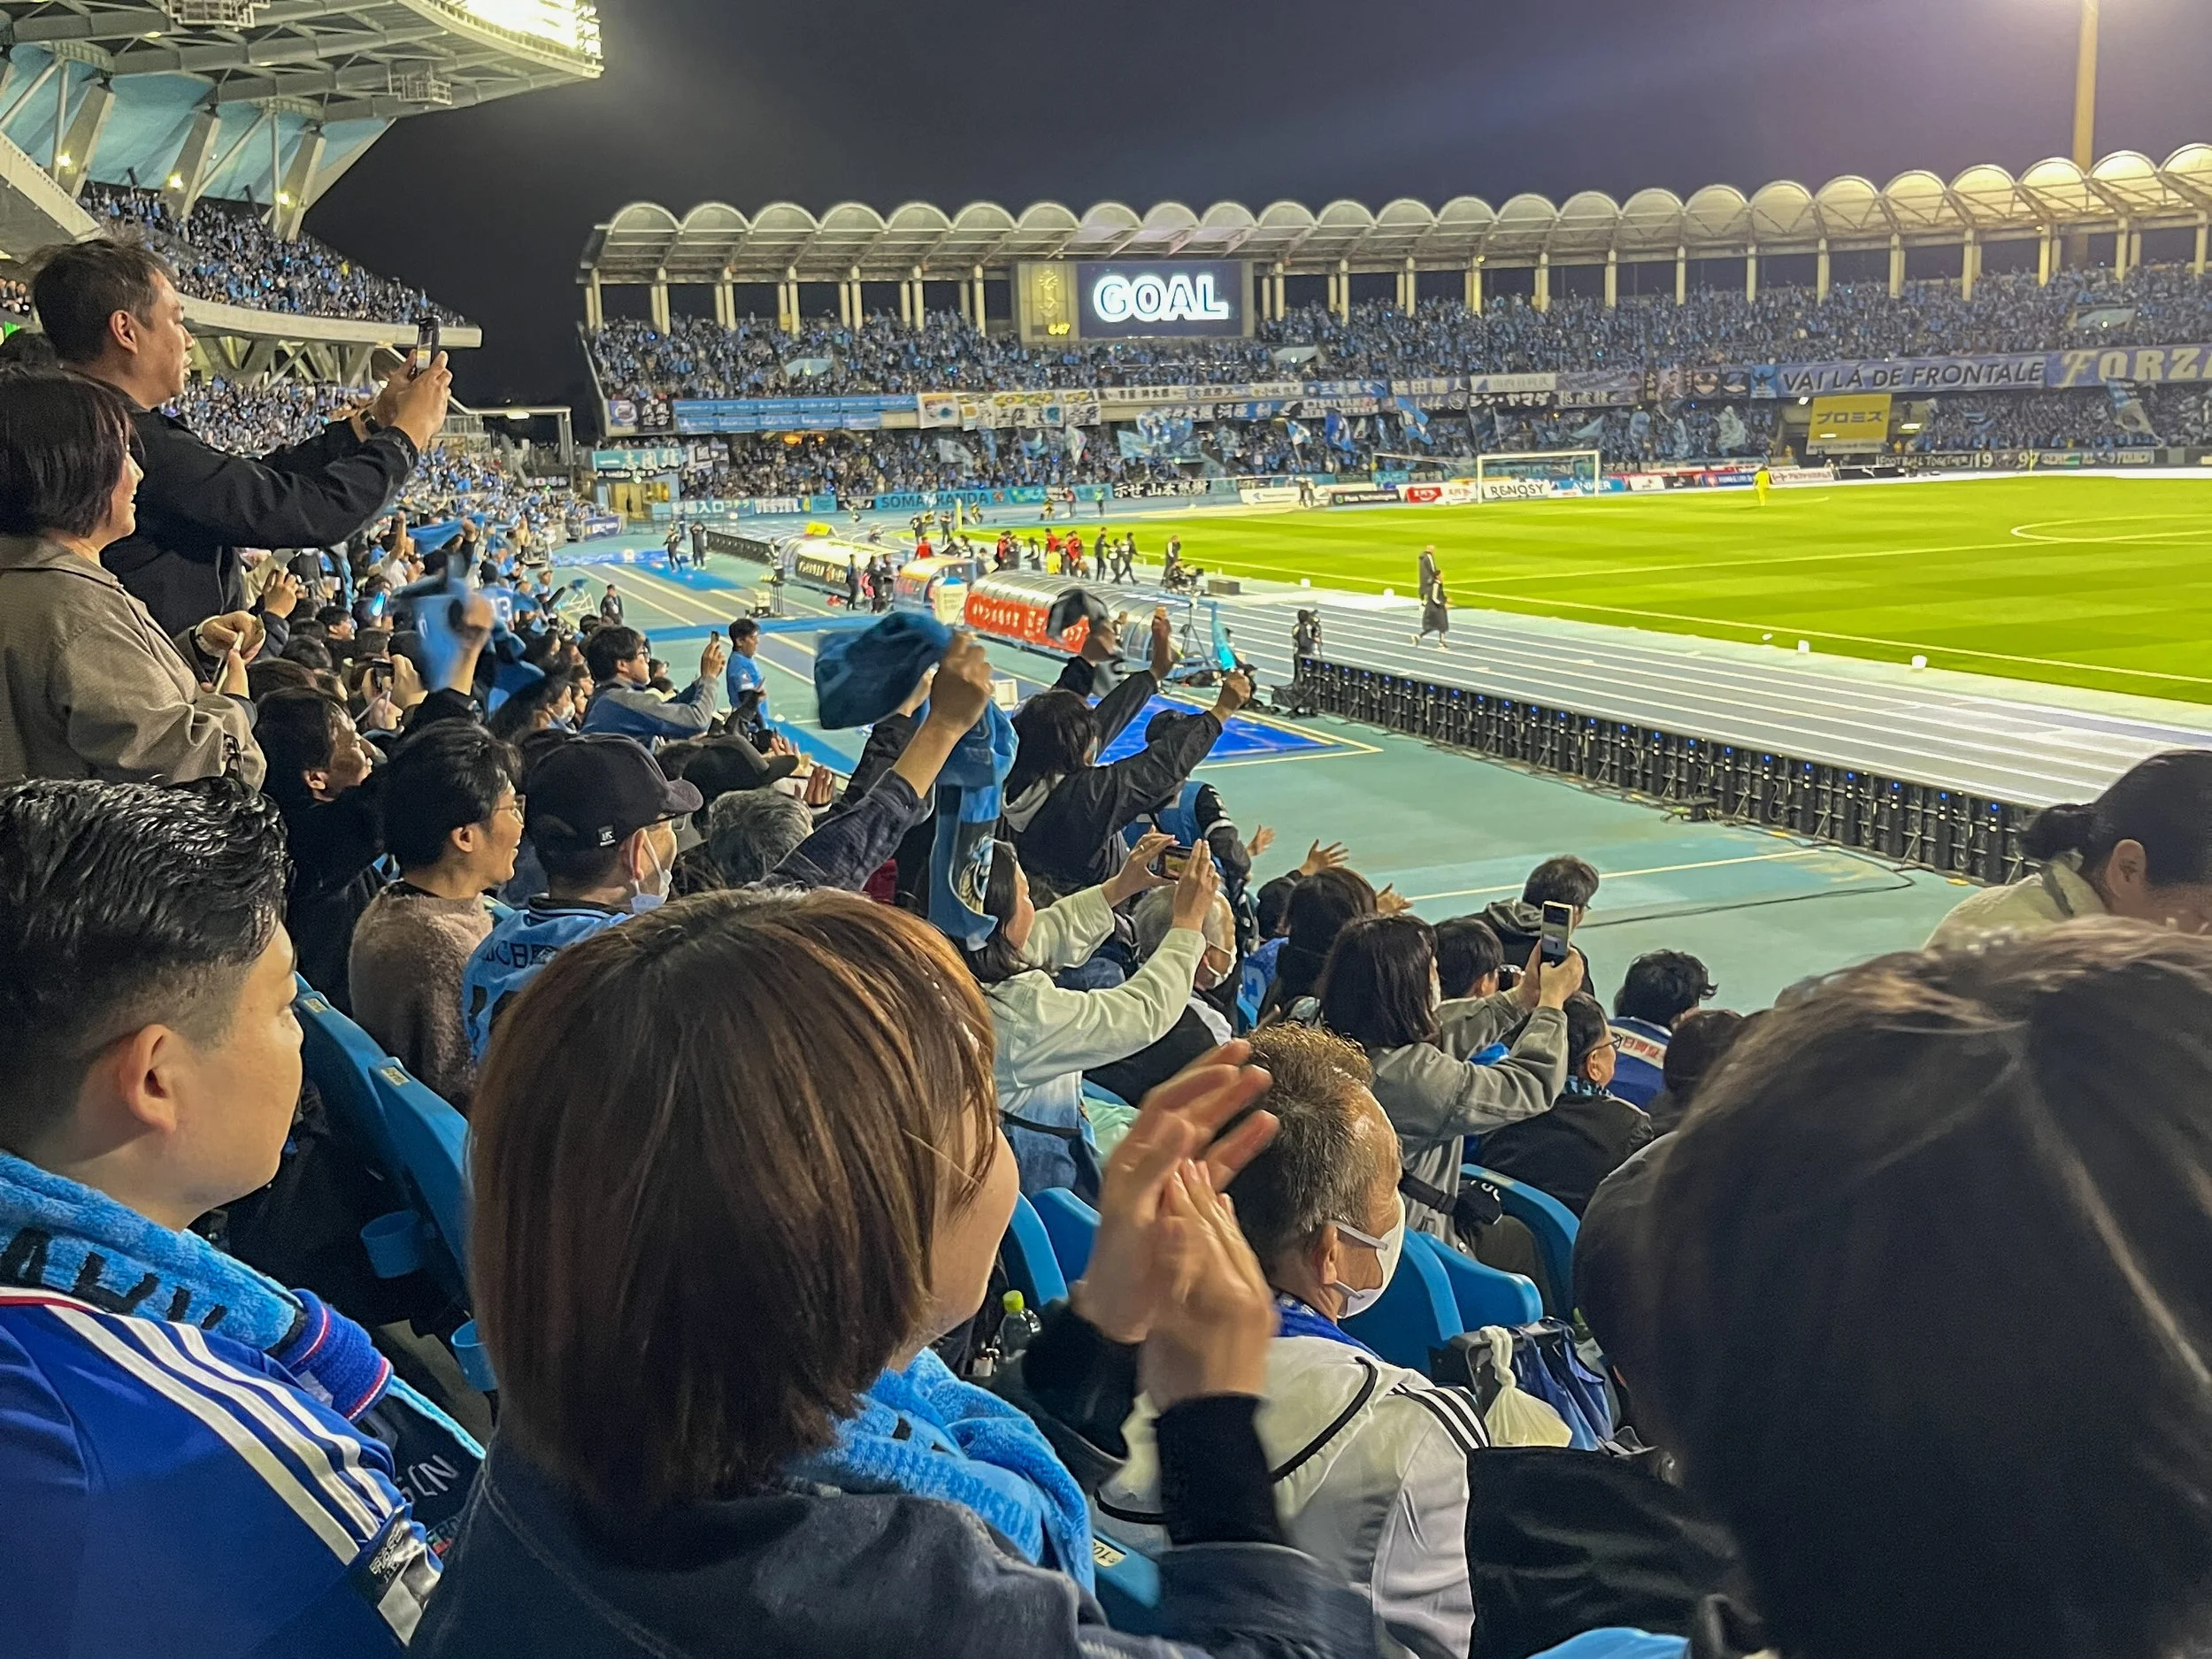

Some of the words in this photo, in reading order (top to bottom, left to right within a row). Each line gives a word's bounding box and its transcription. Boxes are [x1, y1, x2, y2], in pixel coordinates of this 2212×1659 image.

[1093, 274, 1229, 322] GOAL
[1783, 373, 1824, 392] VAI
[1832, 364, 1863, 389] LÁ
[1872, 367, 1903, 388] DE
[1911, 362, 2044, 385] FRONTALE
[1816, 410, 1886, 426] プロミス
[1974, 450, 1993, 468] 19
